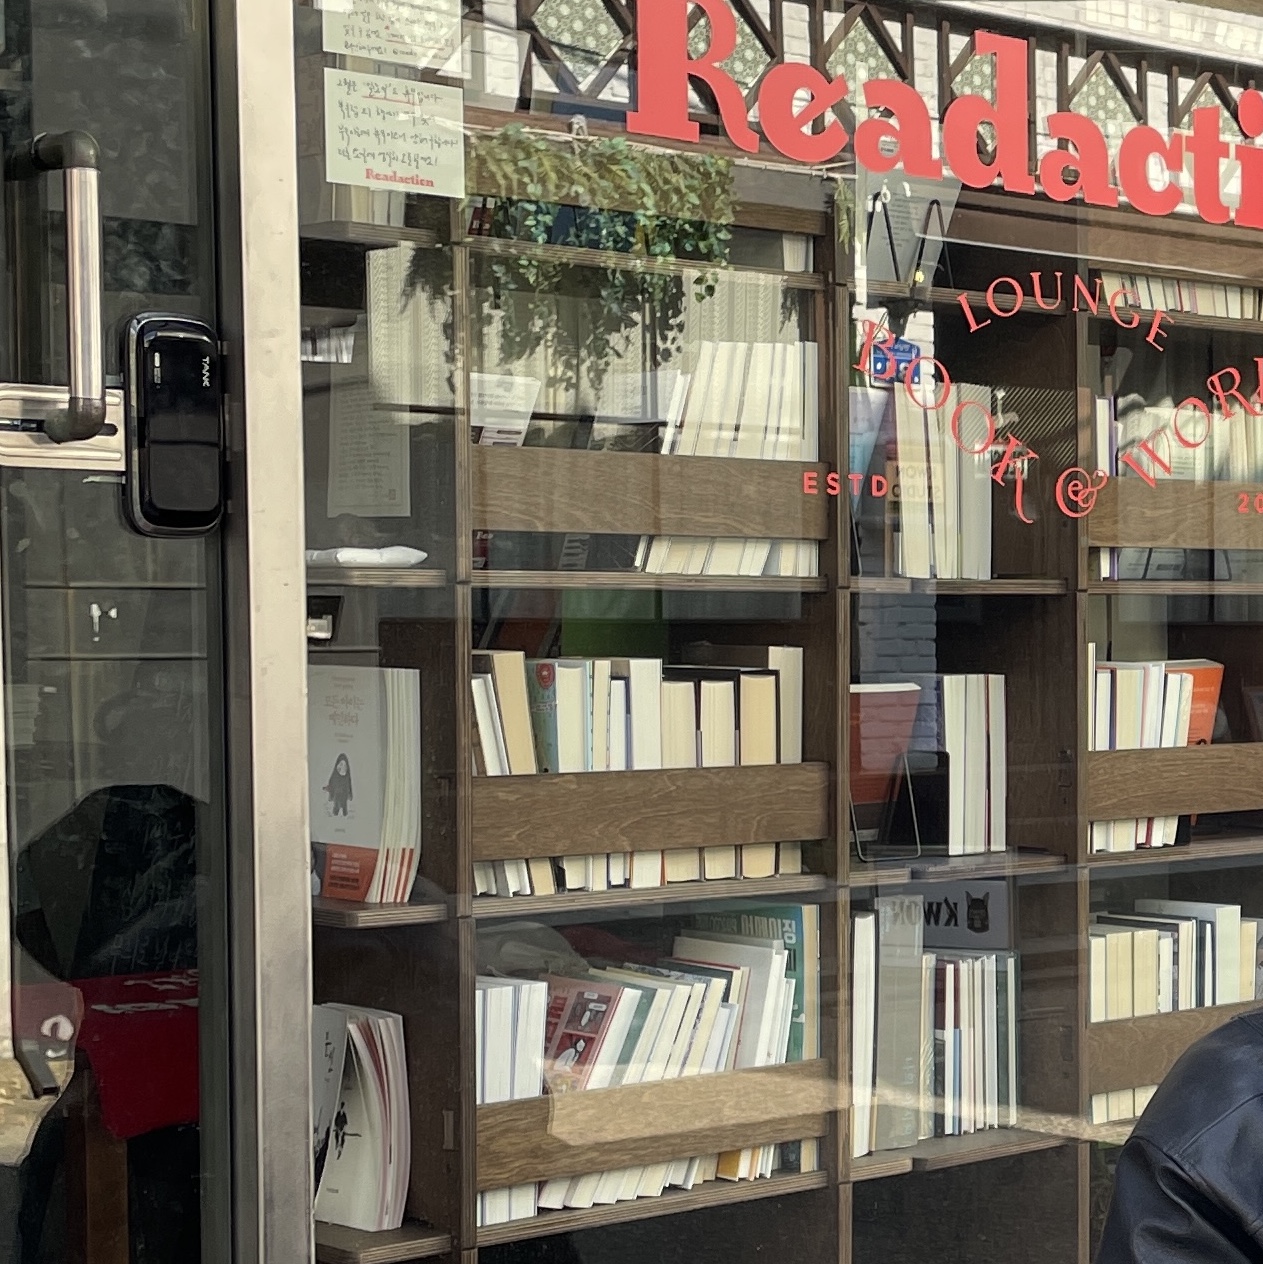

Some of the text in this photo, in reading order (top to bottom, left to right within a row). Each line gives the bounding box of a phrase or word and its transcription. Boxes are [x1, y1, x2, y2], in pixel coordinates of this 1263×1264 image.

[365, 168, 435, 188] Readaction
[957, 271, 1175, 353] LOUNGE
[201, 355, 211, 387] TANK
[852, 319, 1039, 524] BOOK
[803, 471, 890, 498] ESTD
